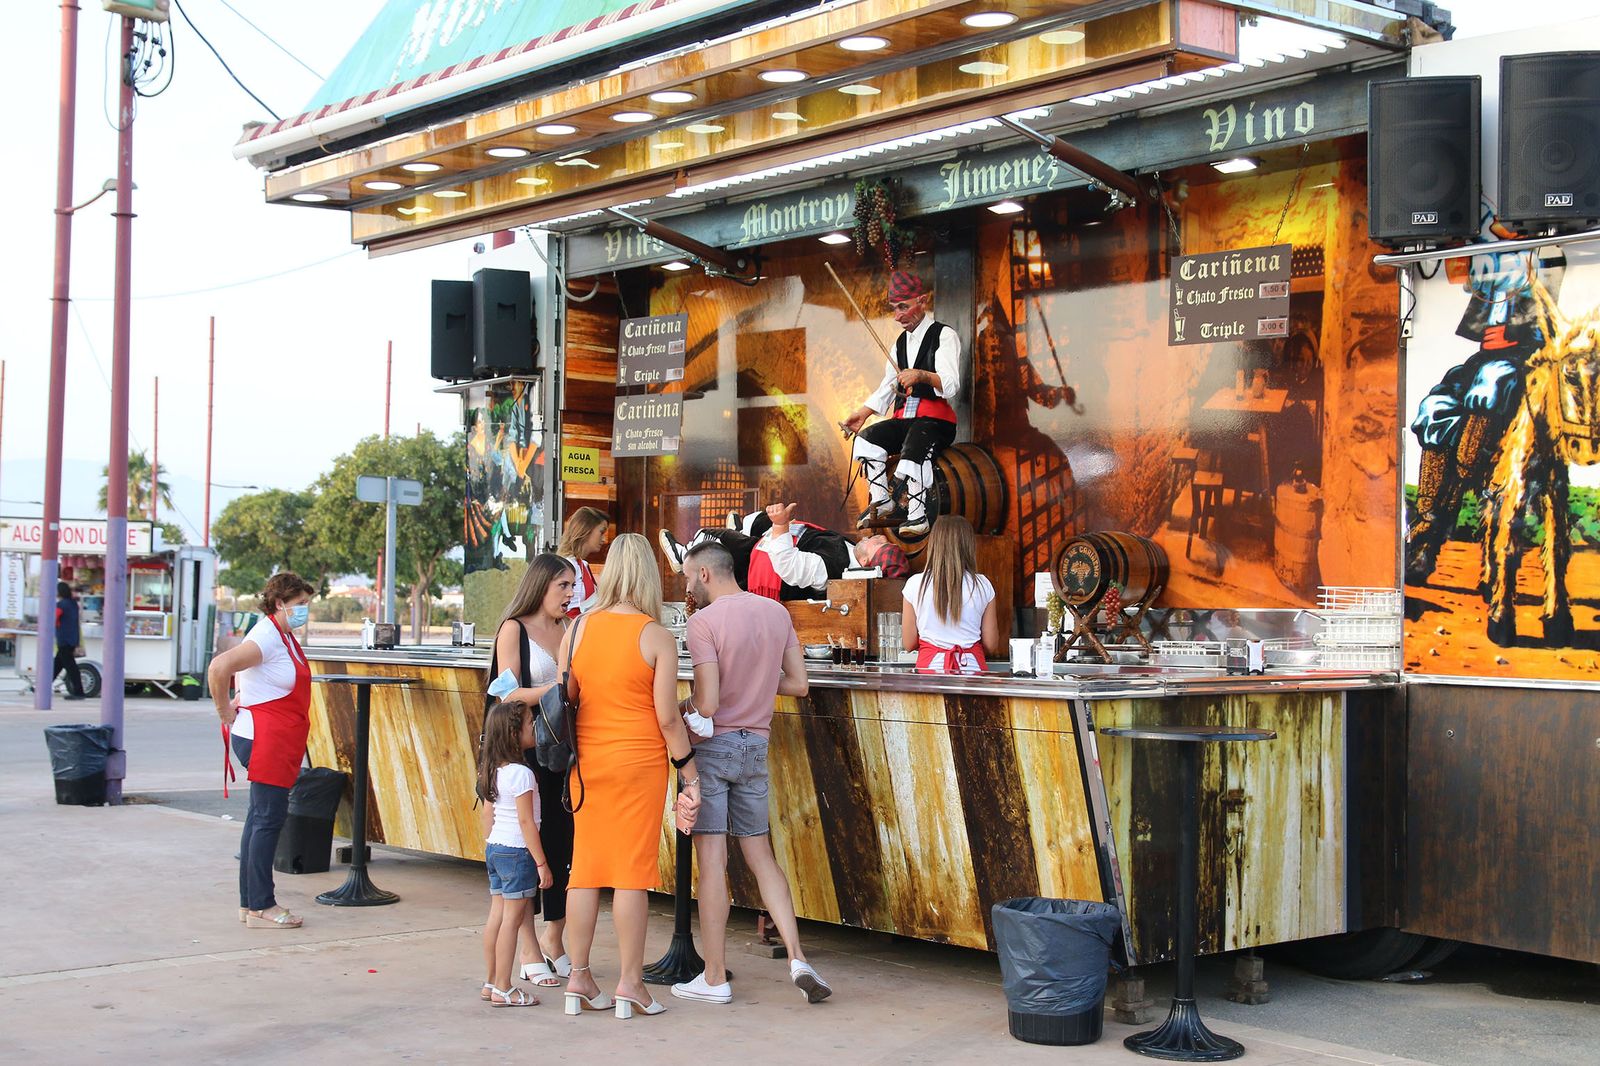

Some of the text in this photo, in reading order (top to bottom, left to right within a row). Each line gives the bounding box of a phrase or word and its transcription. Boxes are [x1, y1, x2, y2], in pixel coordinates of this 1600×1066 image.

[1203, 101, 1316, 152] Vino
[938, 153, 1060, 210] Jimenez
[1547, 195, 1570, 205] PAD
[740, 193, 849, 244] Montroy
[1414, 214, 1435, 223] PAD
[1180, 253, 1281, 280] Cariñena
[1186, 286, 1254, 306] Chato Fresco
[624, 318, 682, 338] Cariñena
[1200, 320, 1245, 339] Triple
[627, 345, 645, 357] Chato
[645, 343, 666, 357] Fresco
[634, 369, 660, 383] Triple
[616, 399, 679, 421] Cariñena
[625, 427, 664, 439] Chato Fresco
[638, 440, 658, 451] alcohol
[568, 452, 591, 461] AGUA
[563, 465, 595, 475] FRESCA
[89, 528, 136, 546] DUE
